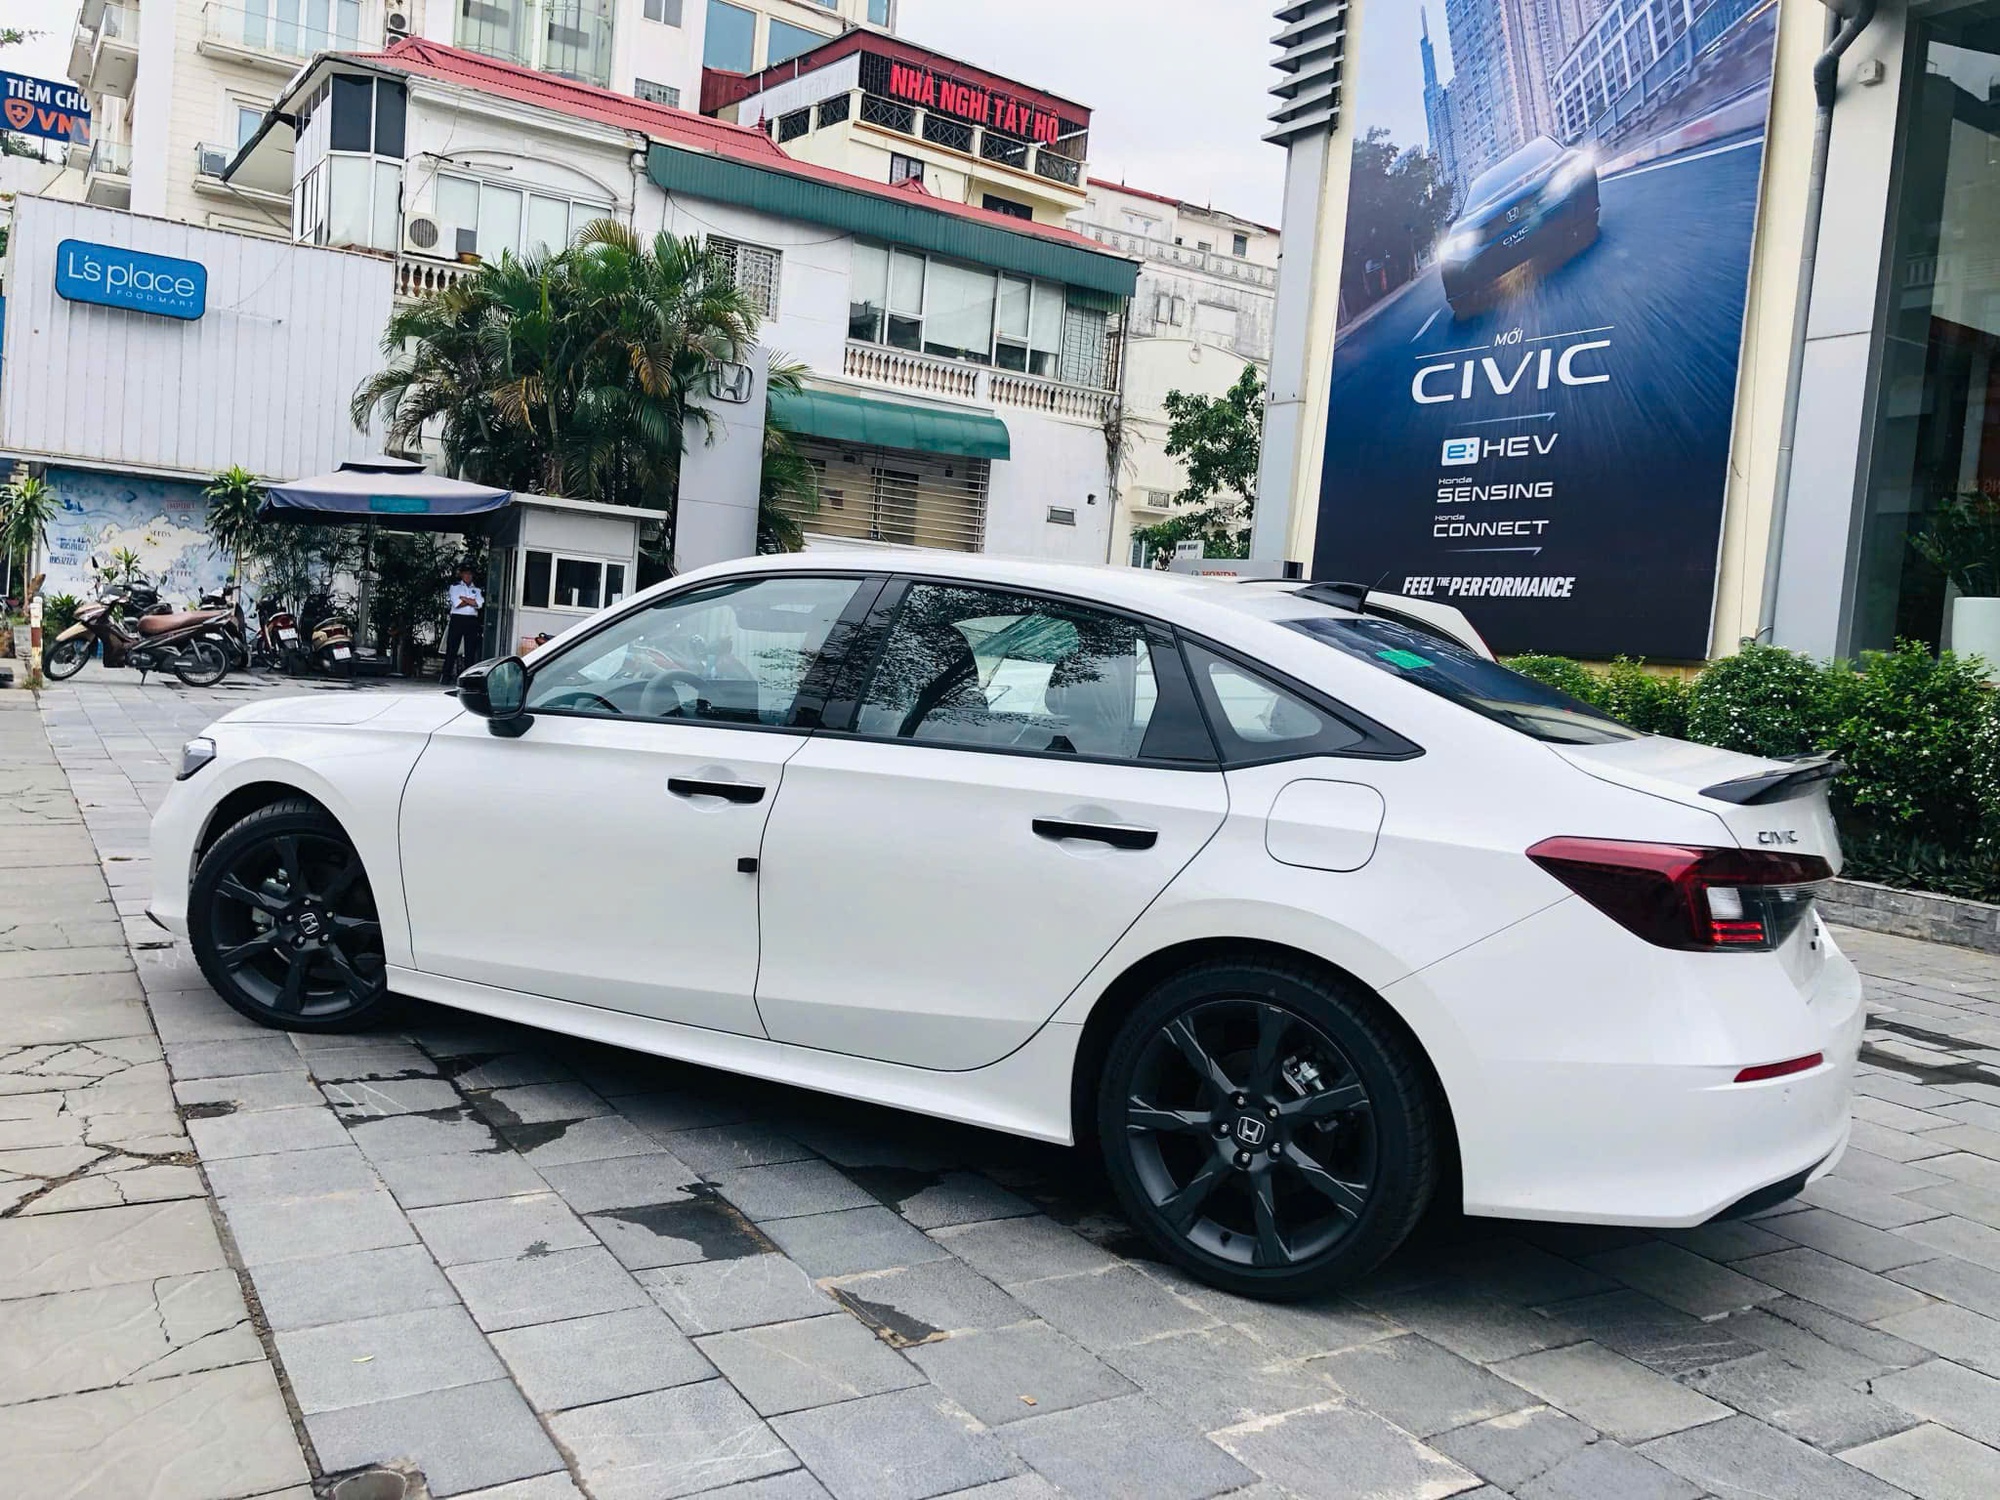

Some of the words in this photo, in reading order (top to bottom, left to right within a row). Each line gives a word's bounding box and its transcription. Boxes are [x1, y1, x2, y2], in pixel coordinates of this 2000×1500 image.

[7, 77, 51, 104] TIÊM
[889, 64, 935, 107] NHÀ
[939, 86, 992, 124] NGHỈ
[994, 96, 1030, 136] TÂY
[68, 252, 101, 282] L's
[106, 263, 195, 297] place
[1494, 327, 1524, 347] MỚI
[1411, 339, 1611, 404] CIVIC
[1438, 476, 1472, 485] Honda
[1436, 481, 1554, 503] SENSING
[1434, 513, 1466, 521] Honda
[1433, 520, 1550, 538] CONNECT
[1402, 576, 1435, 596] FEEL
[1436, 576, 1451, 587] THE
[1448, 576, 1576, 598] PERFORMANCE
